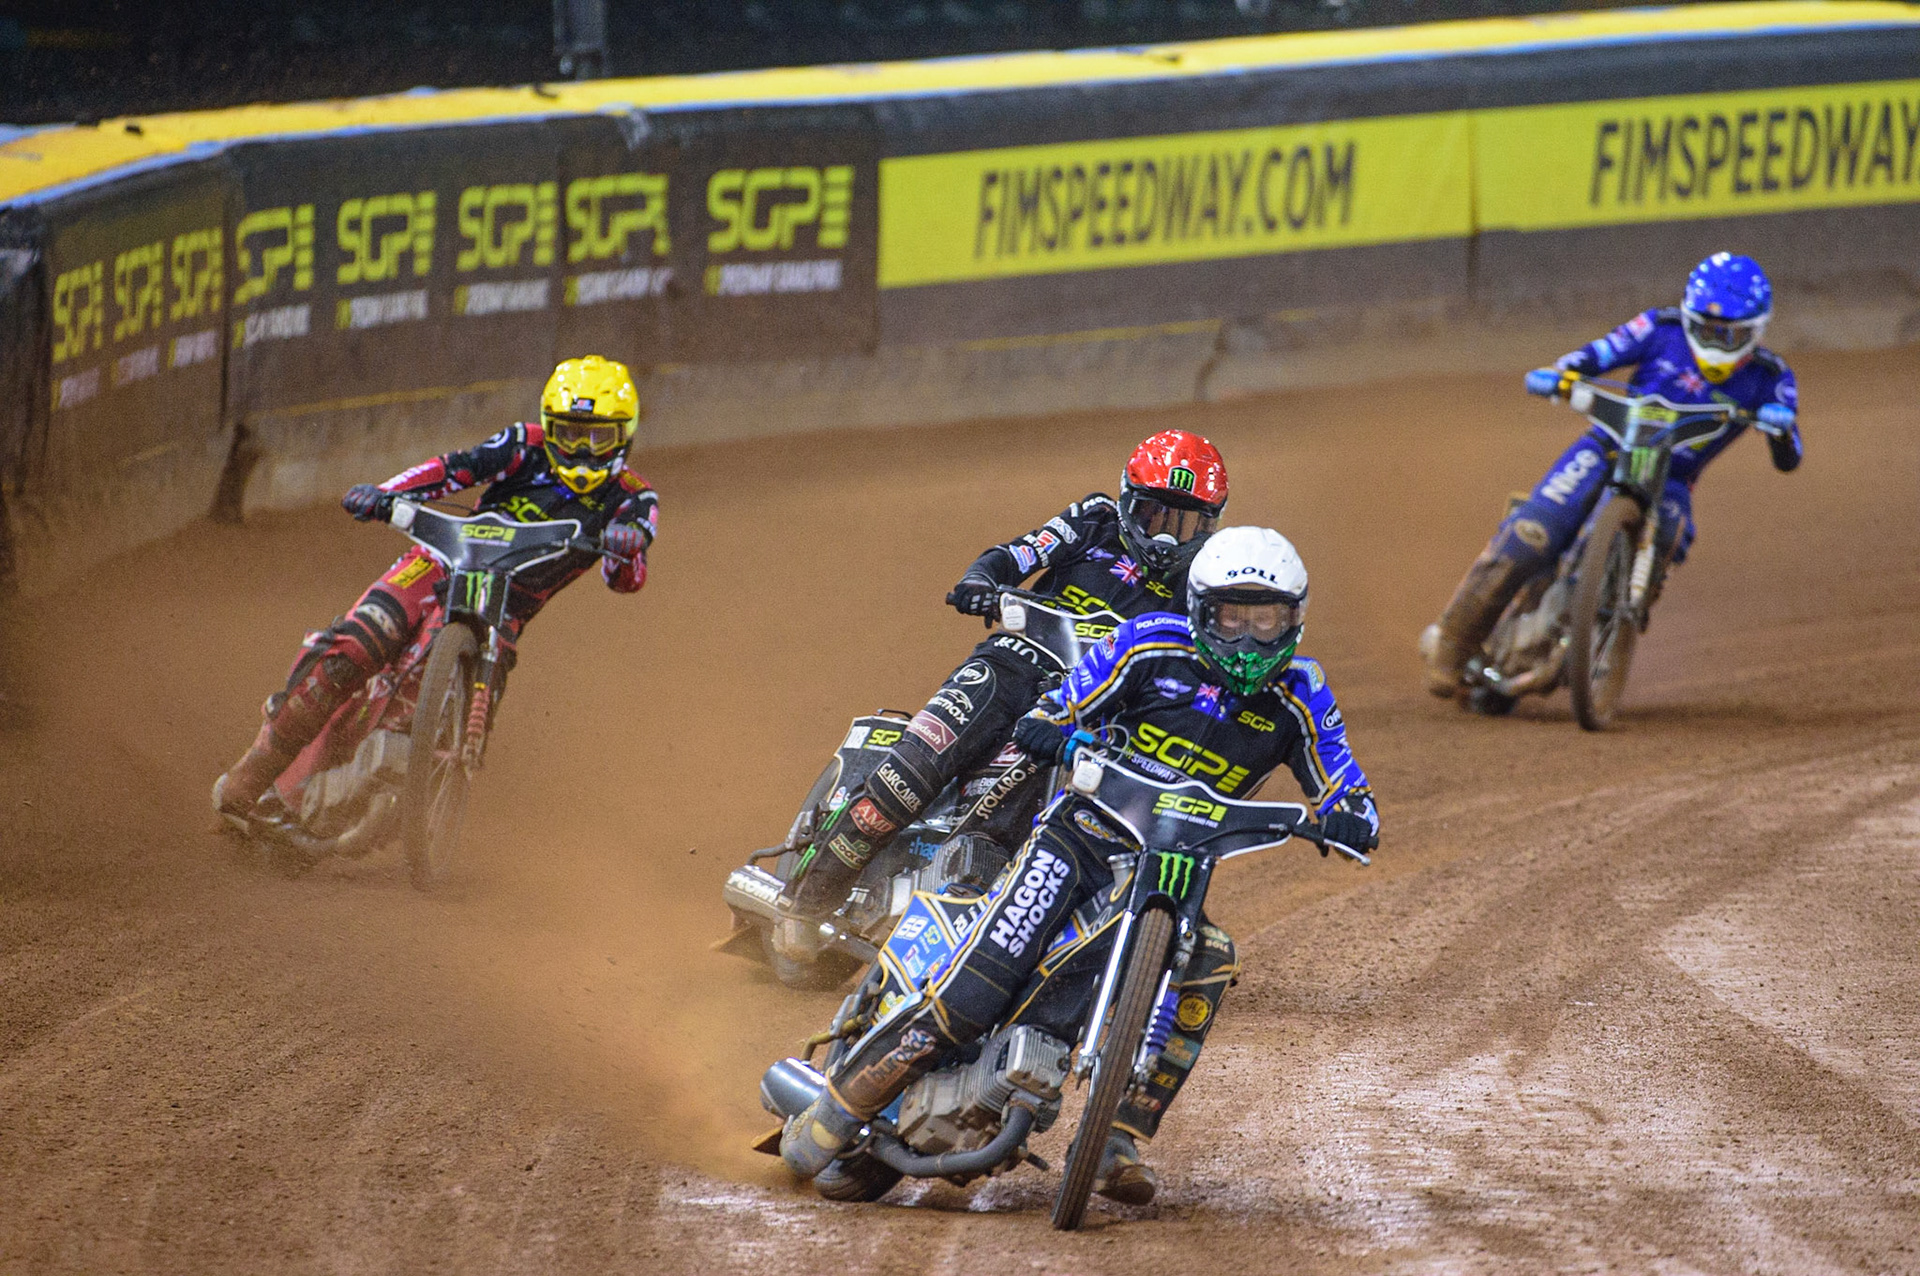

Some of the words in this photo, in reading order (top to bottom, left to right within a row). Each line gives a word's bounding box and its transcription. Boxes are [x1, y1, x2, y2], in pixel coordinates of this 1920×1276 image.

[974, 138, 1358, 259] FIMSPEEDWAY.COM
[1590, 99, 1920, 205] FIMSPEEDWAY
[989, 848, 1056, 949] HAGON
[1007, 858, 1071, 958] SHOCKS
